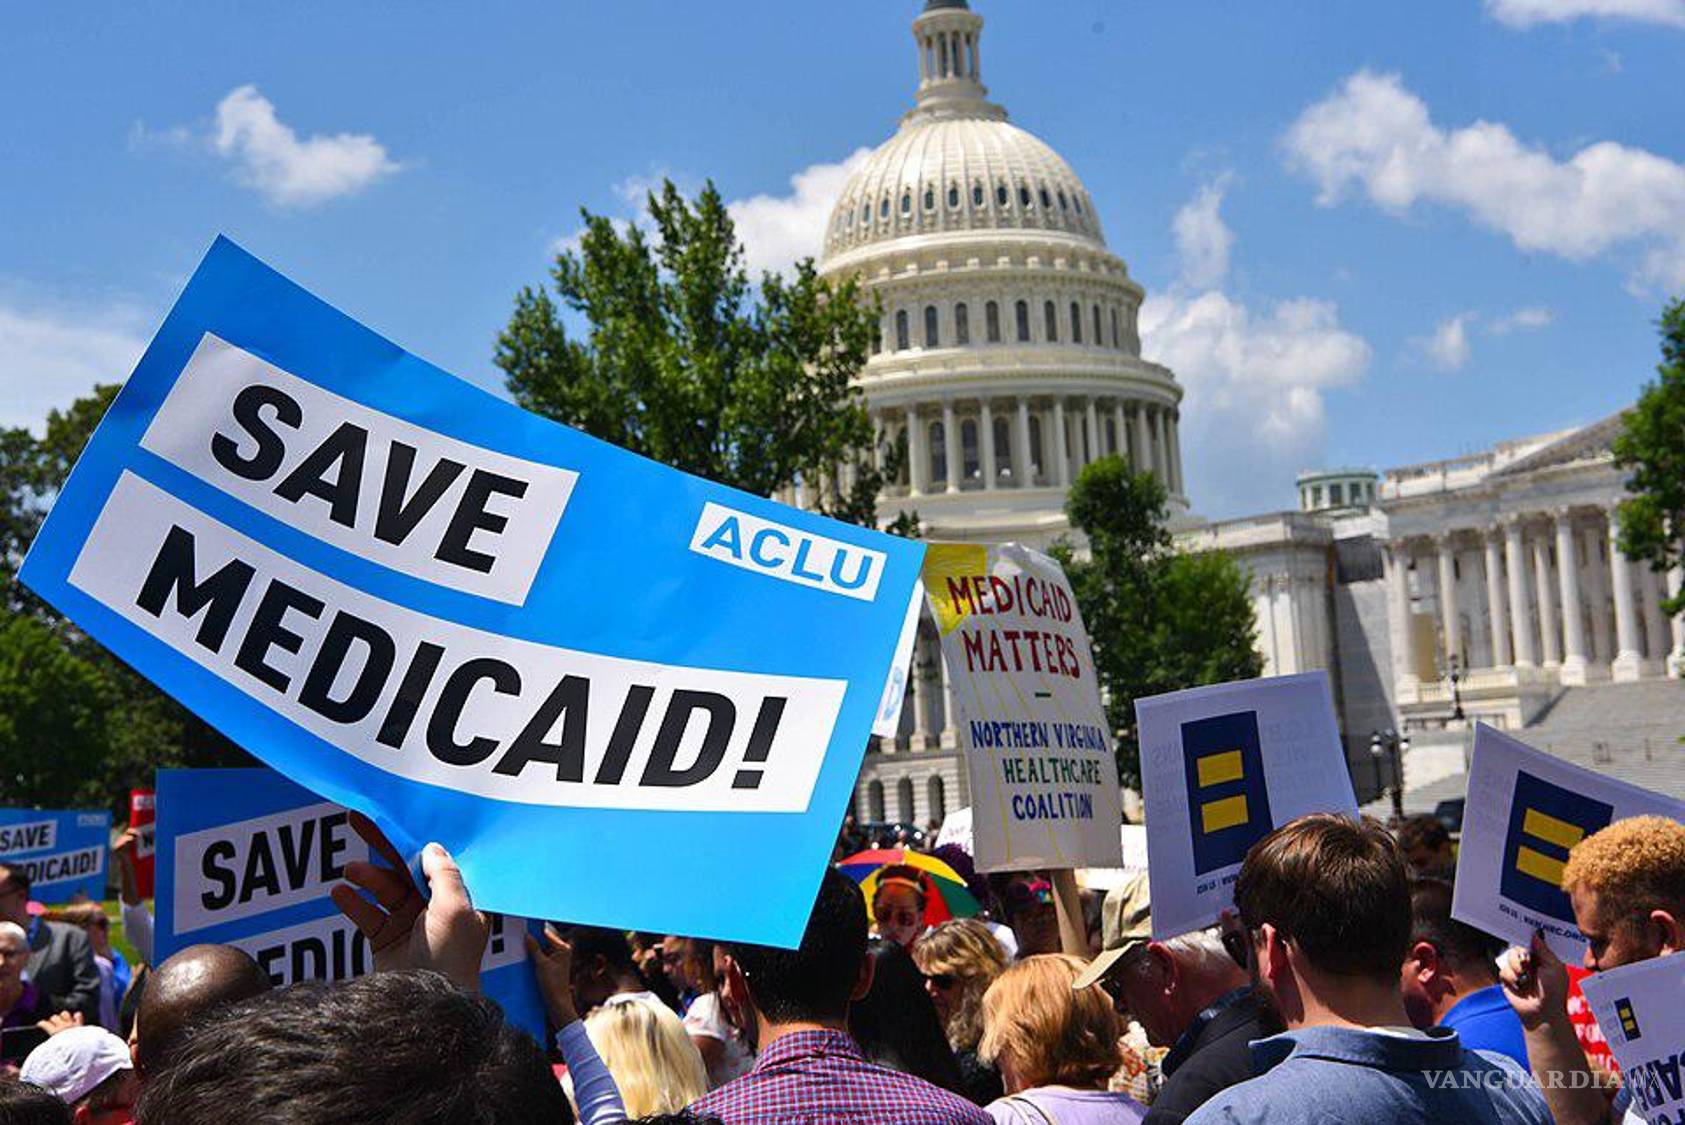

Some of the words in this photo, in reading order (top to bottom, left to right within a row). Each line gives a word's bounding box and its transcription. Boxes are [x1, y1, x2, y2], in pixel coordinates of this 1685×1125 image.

[211, 384, 529, 574] SAVE
[701, 516, 874, 590] ACLU
[947, 575, 1072, 623] MEDICAID
[136, 524, 788, 790] MEDICAID!
[962, 630, 1081, 679] MATTERS
[970, 720, 1050, 749] NORTHERN
[1053, 723, 1106, 752] VIRGINIA
[1002, 758, 1101, 785] HEALTHCARE
[1012, 793, 1093, 821] COALITION
[0, 824, 50, 851] SAVE
[201, 812, 348, 911] SAVE
[21, 848, 97, 883] DICAID!
